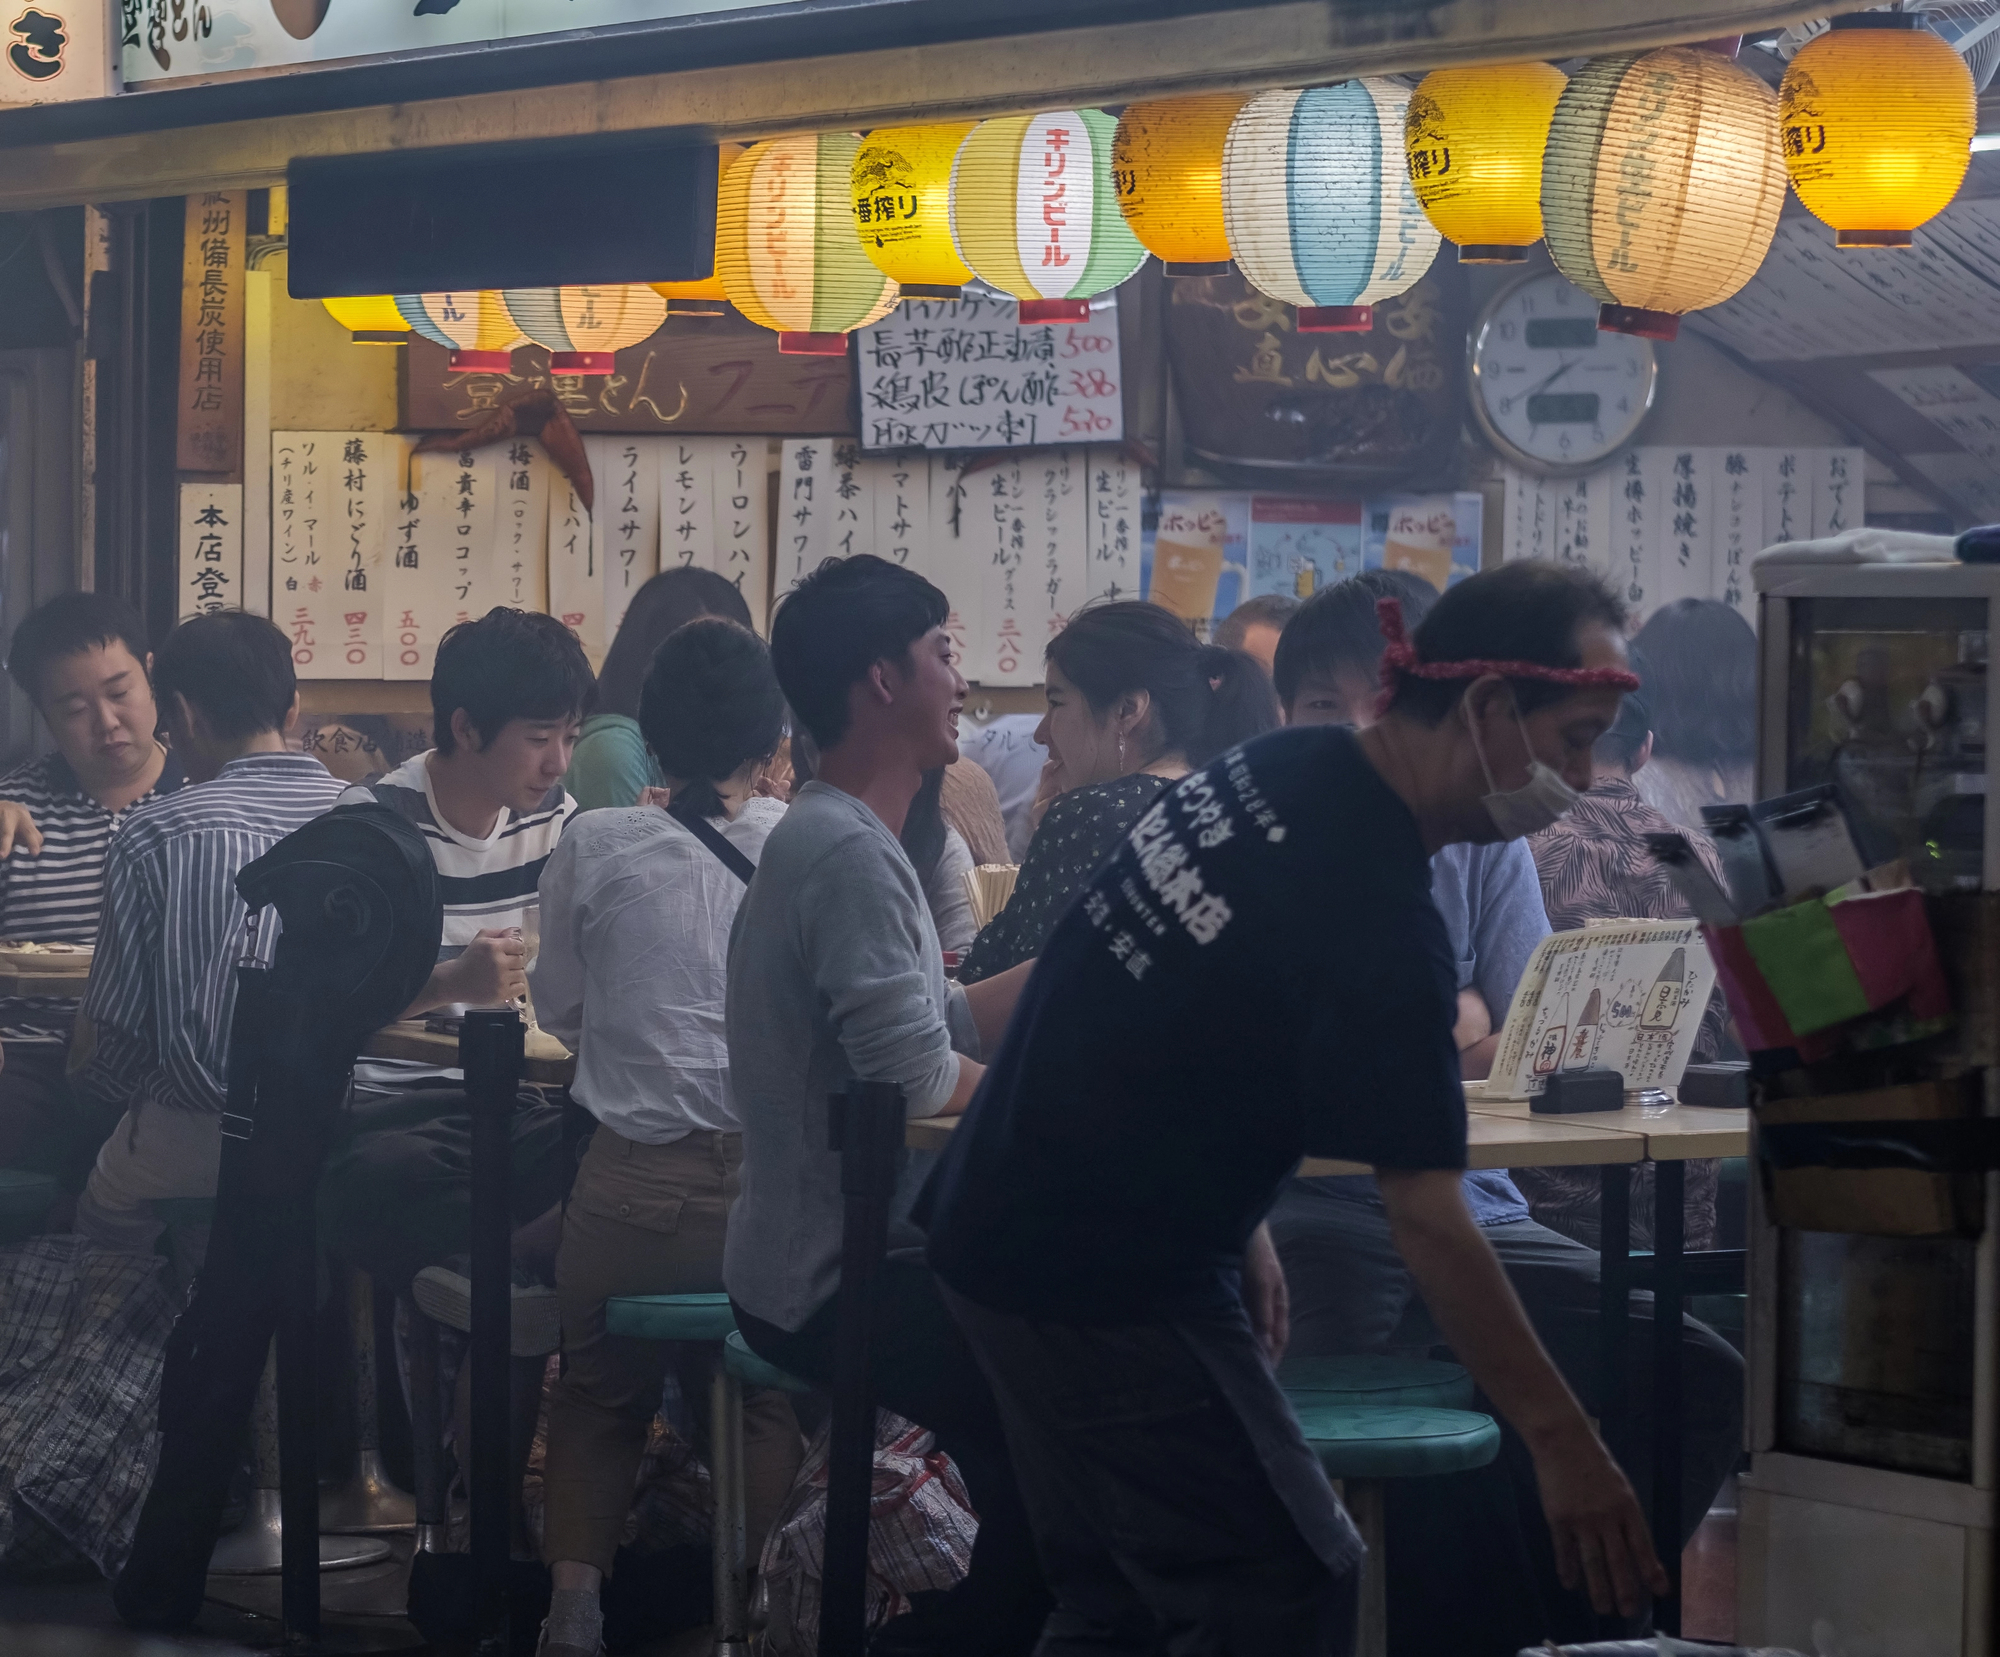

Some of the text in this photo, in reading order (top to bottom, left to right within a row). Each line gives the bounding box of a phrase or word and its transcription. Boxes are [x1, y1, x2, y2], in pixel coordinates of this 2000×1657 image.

[767, 154, 796, 299] キリンビール
[853, 195, 917, 223] 番搾り
[1042, 129, 1070, 266] キリンビール
[1060, 326, 1114, 359] 500
[343, 438, 368, 592] 藤村にごり酒
[395, 493, 421, 569] ゆず酒
[618, 446, 641, 587] ライムサワー
[729, 444, 751, 590] ウーロンハイ
[792, 446, 817, 573] 雷門サワー
[991, 474, 1011, 565] 生ビール
[1096, 470, 1113, 561] 生ビール
[1828, 456, 1849, 530] おでん
